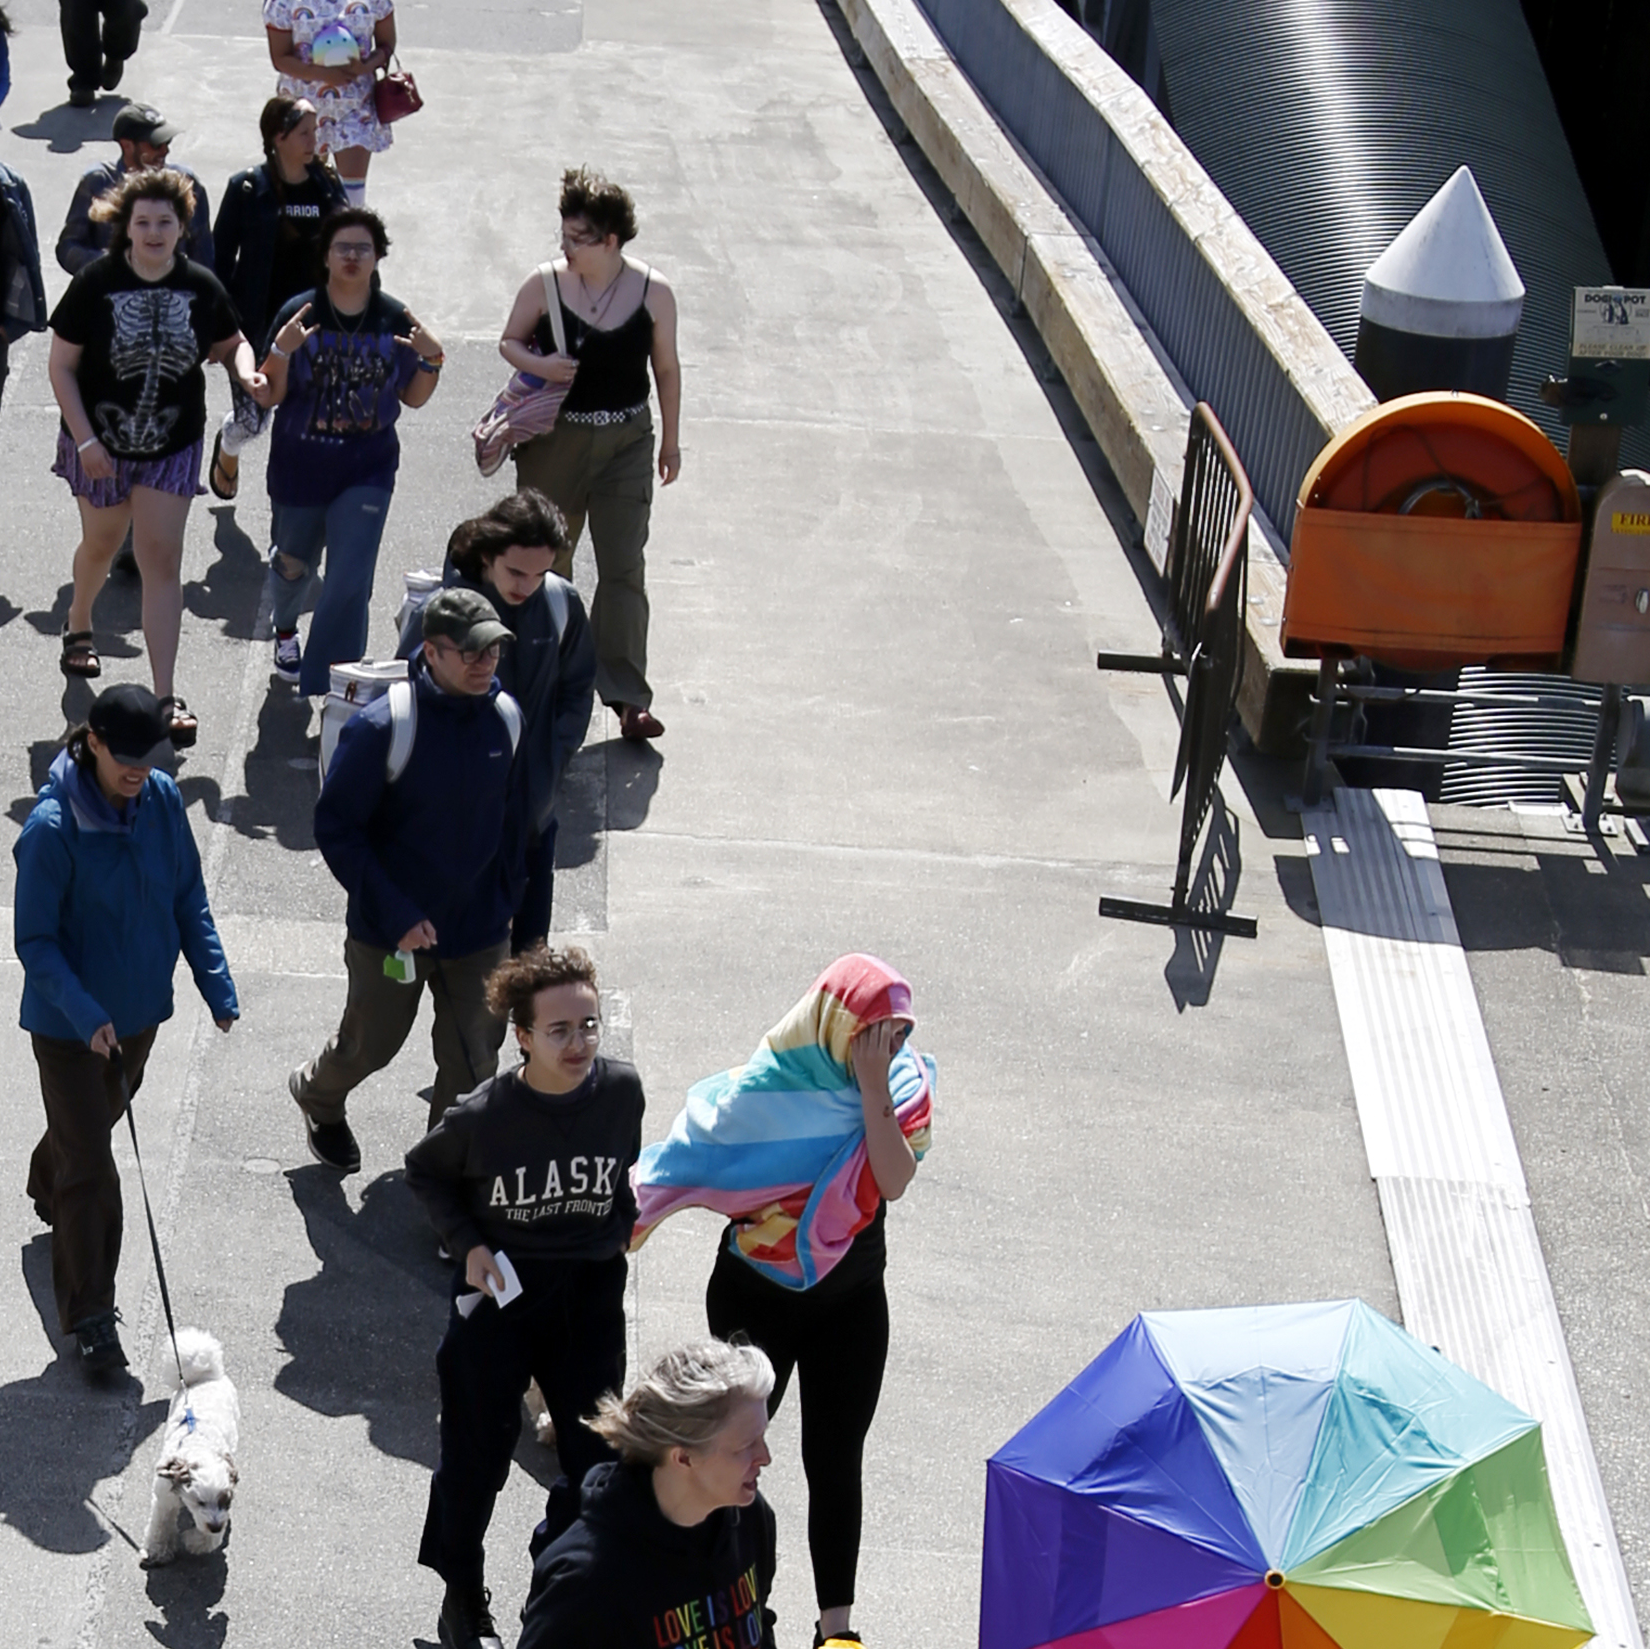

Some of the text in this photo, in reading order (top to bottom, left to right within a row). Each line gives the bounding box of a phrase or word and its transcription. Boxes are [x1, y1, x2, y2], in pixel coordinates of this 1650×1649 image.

[277, 205, 320, 218] RRIOR
[489, 1155, 624, 1206] ALASK
[505, 1208, 531, 1223] THE
[532, 1201, 563, 1221] LAST
[653, 1562, 758, 1649] LOVE IS LOV
